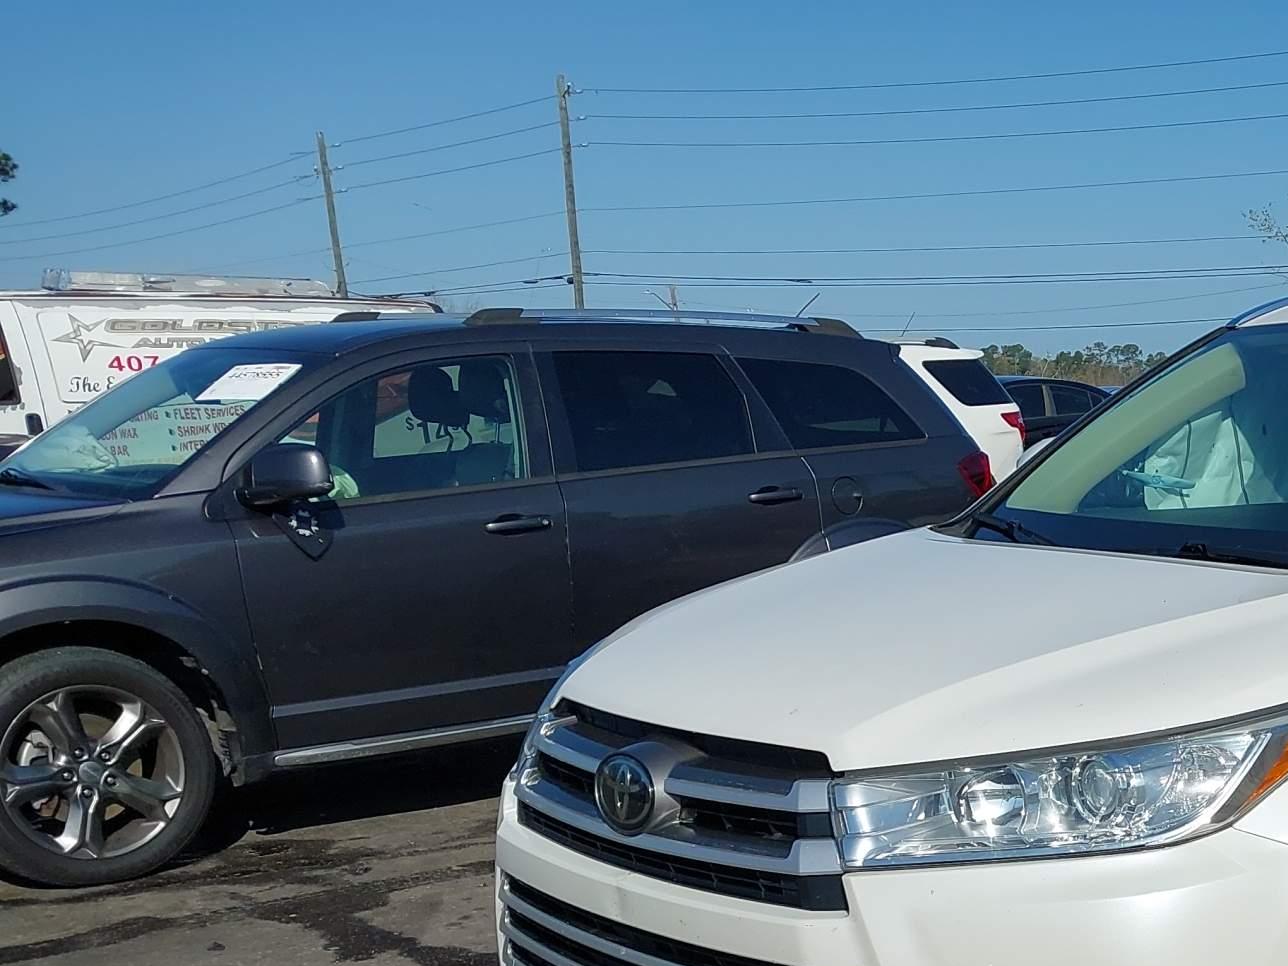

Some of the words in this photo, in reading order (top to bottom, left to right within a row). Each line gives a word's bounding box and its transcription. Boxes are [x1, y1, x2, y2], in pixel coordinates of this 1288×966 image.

[108, 355, 160, 372] 407
[69, 376, 101, 393] The
[173, 407, 202, 421] FLEET
[203, 403, 246, 420] SERVICES
[119, 427, 139, 441] WAX
[177, 423, 211, 438] SHRINK
[110, 445, 130, 457] BAR
